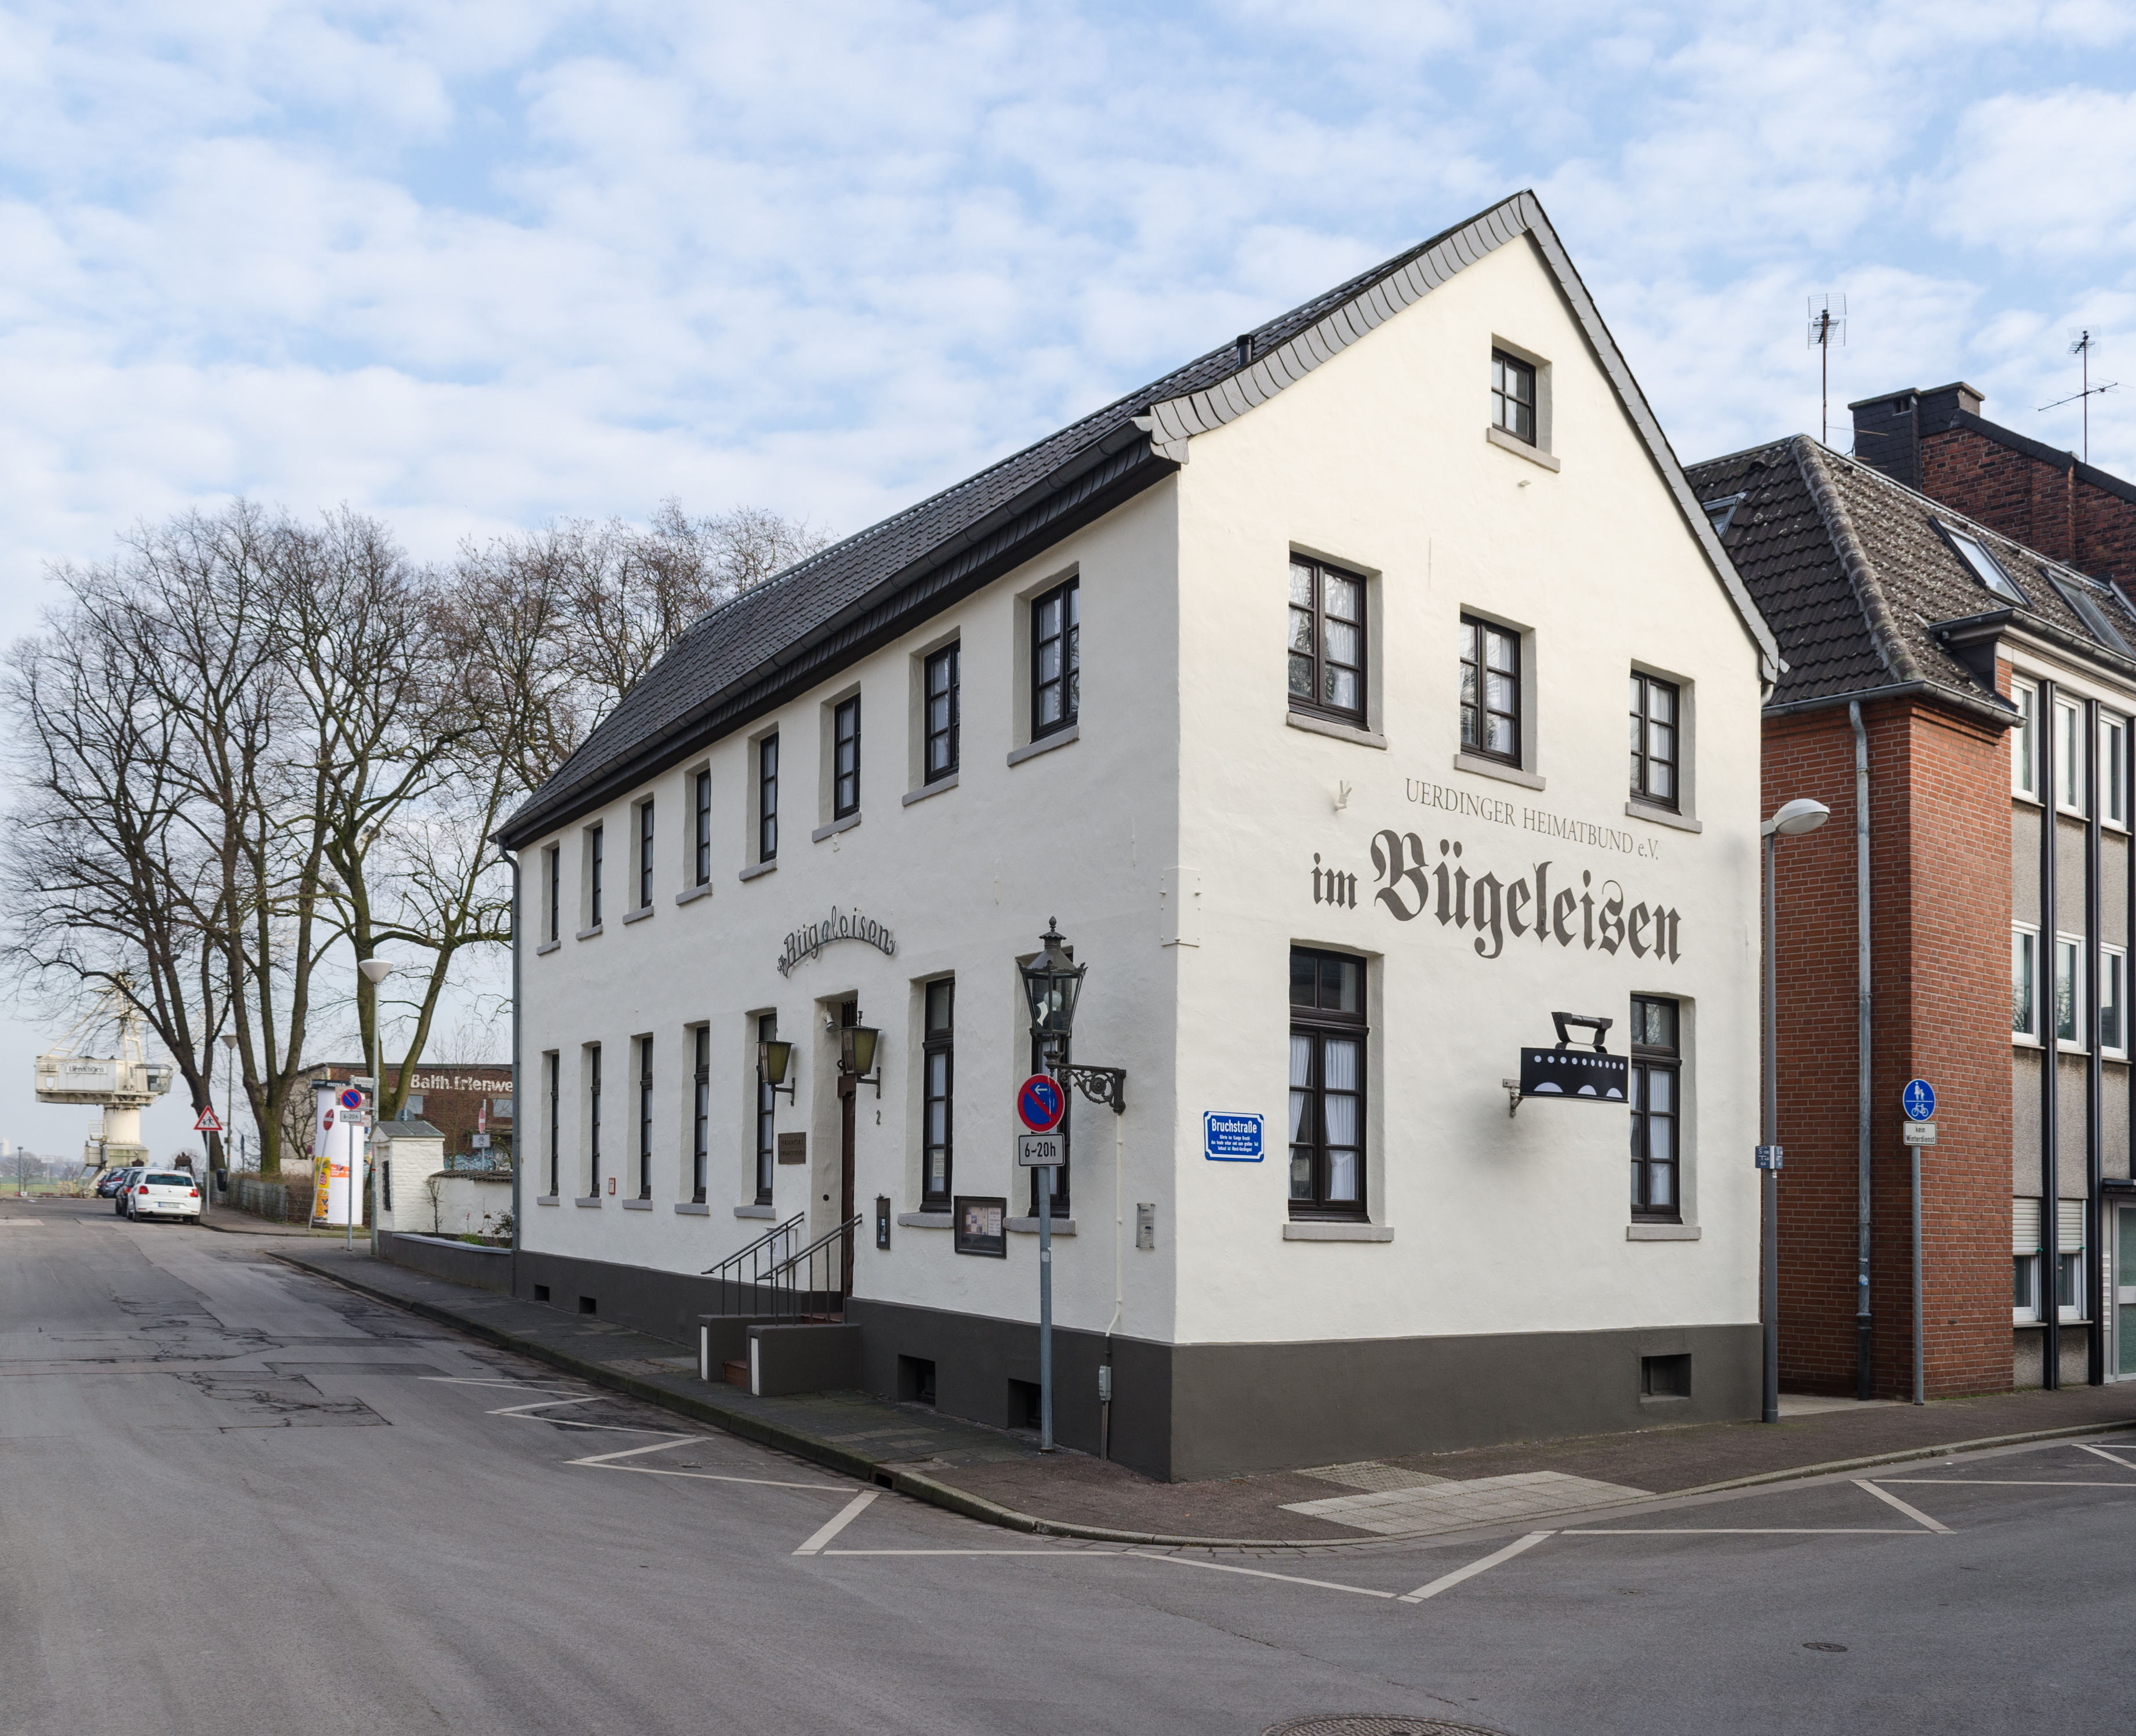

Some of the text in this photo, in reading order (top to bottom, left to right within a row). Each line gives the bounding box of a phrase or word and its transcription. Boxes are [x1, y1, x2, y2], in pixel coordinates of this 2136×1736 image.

[1405, 778, 1659, 860] UERDINGER HEIMATBUND e.V.
[1311, 829, 1681, 965] im Bügeleisen
[783, 905, 896, 965] Bügeleisen
[1212, 1118, 1257, 1134] Bruchstraße
[1905, 1135, 1935, 1143] Winterdienst
[1025, 1141, 1056, 1158] 6-20h
